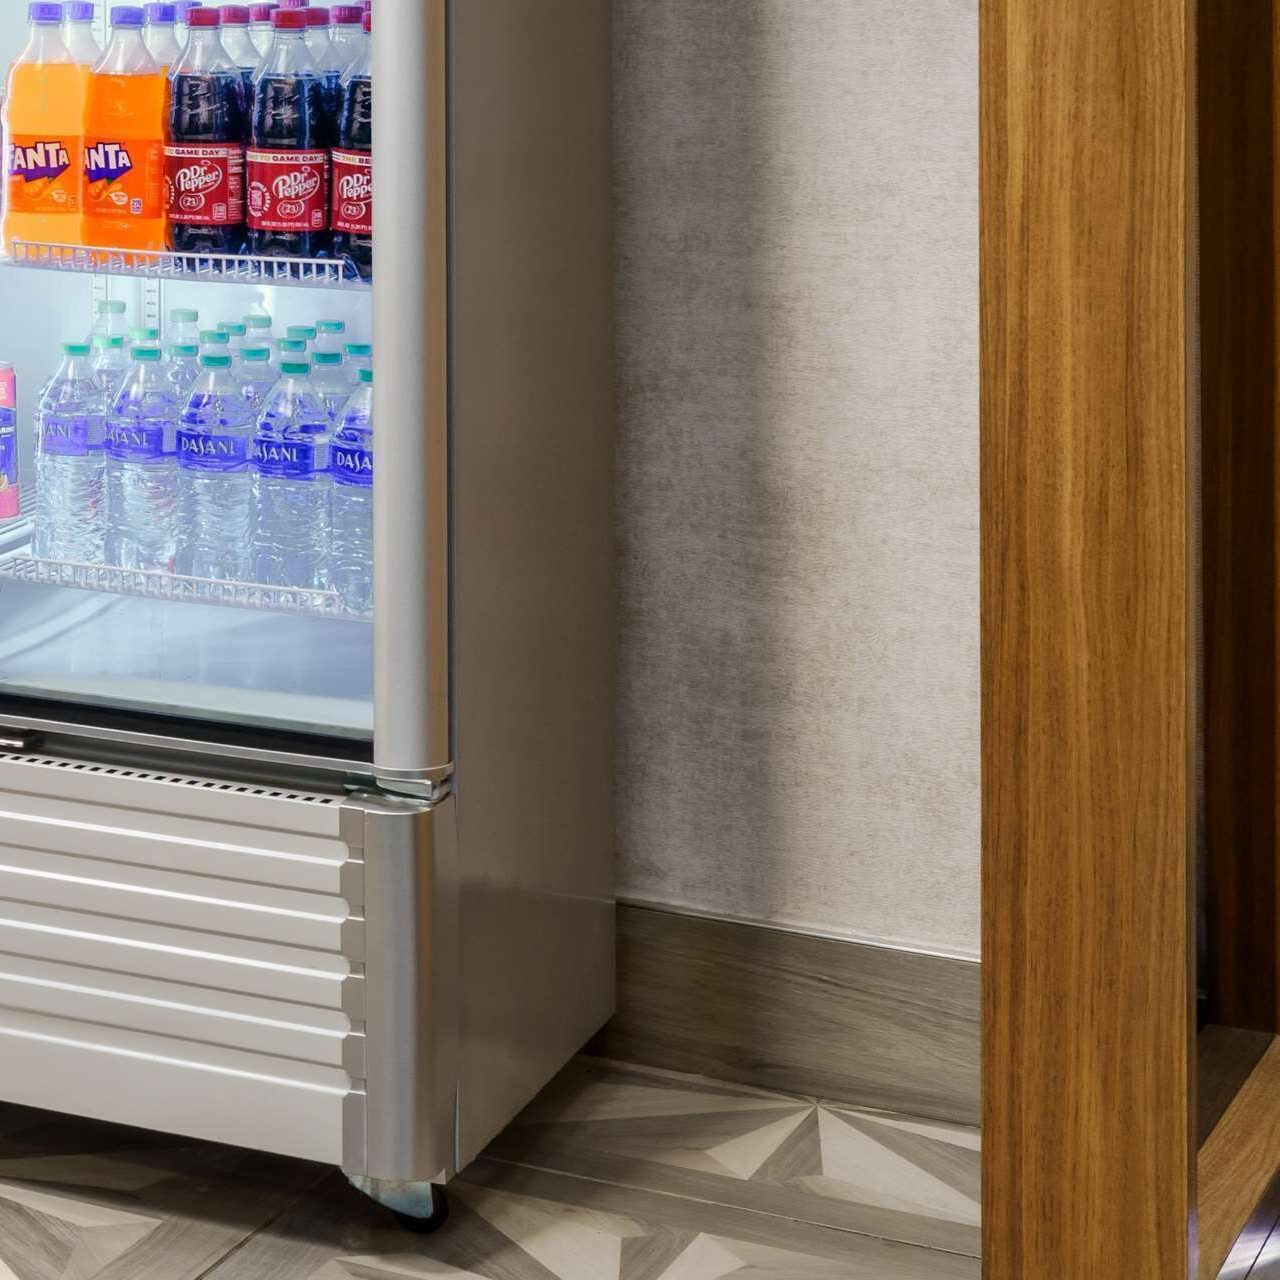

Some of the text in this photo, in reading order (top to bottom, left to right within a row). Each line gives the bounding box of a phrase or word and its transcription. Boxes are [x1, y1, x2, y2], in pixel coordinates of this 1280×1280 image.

[84, 143, 132, 171] ANTA
[272, 155, 319, 163] GAME DAY
[177, 168, 220, 192] Pepper
[192, 163, 208, 179] Dr
[290, 171, 305, 185] Dr
[274, 174, 318, 199] Pepper
[108, 429, 147, 446] ASANI
[180, 436, 235, 456] DASANI
[256, 441, 298, 463] ASANI
[336, 451, 372, 473] DASA
